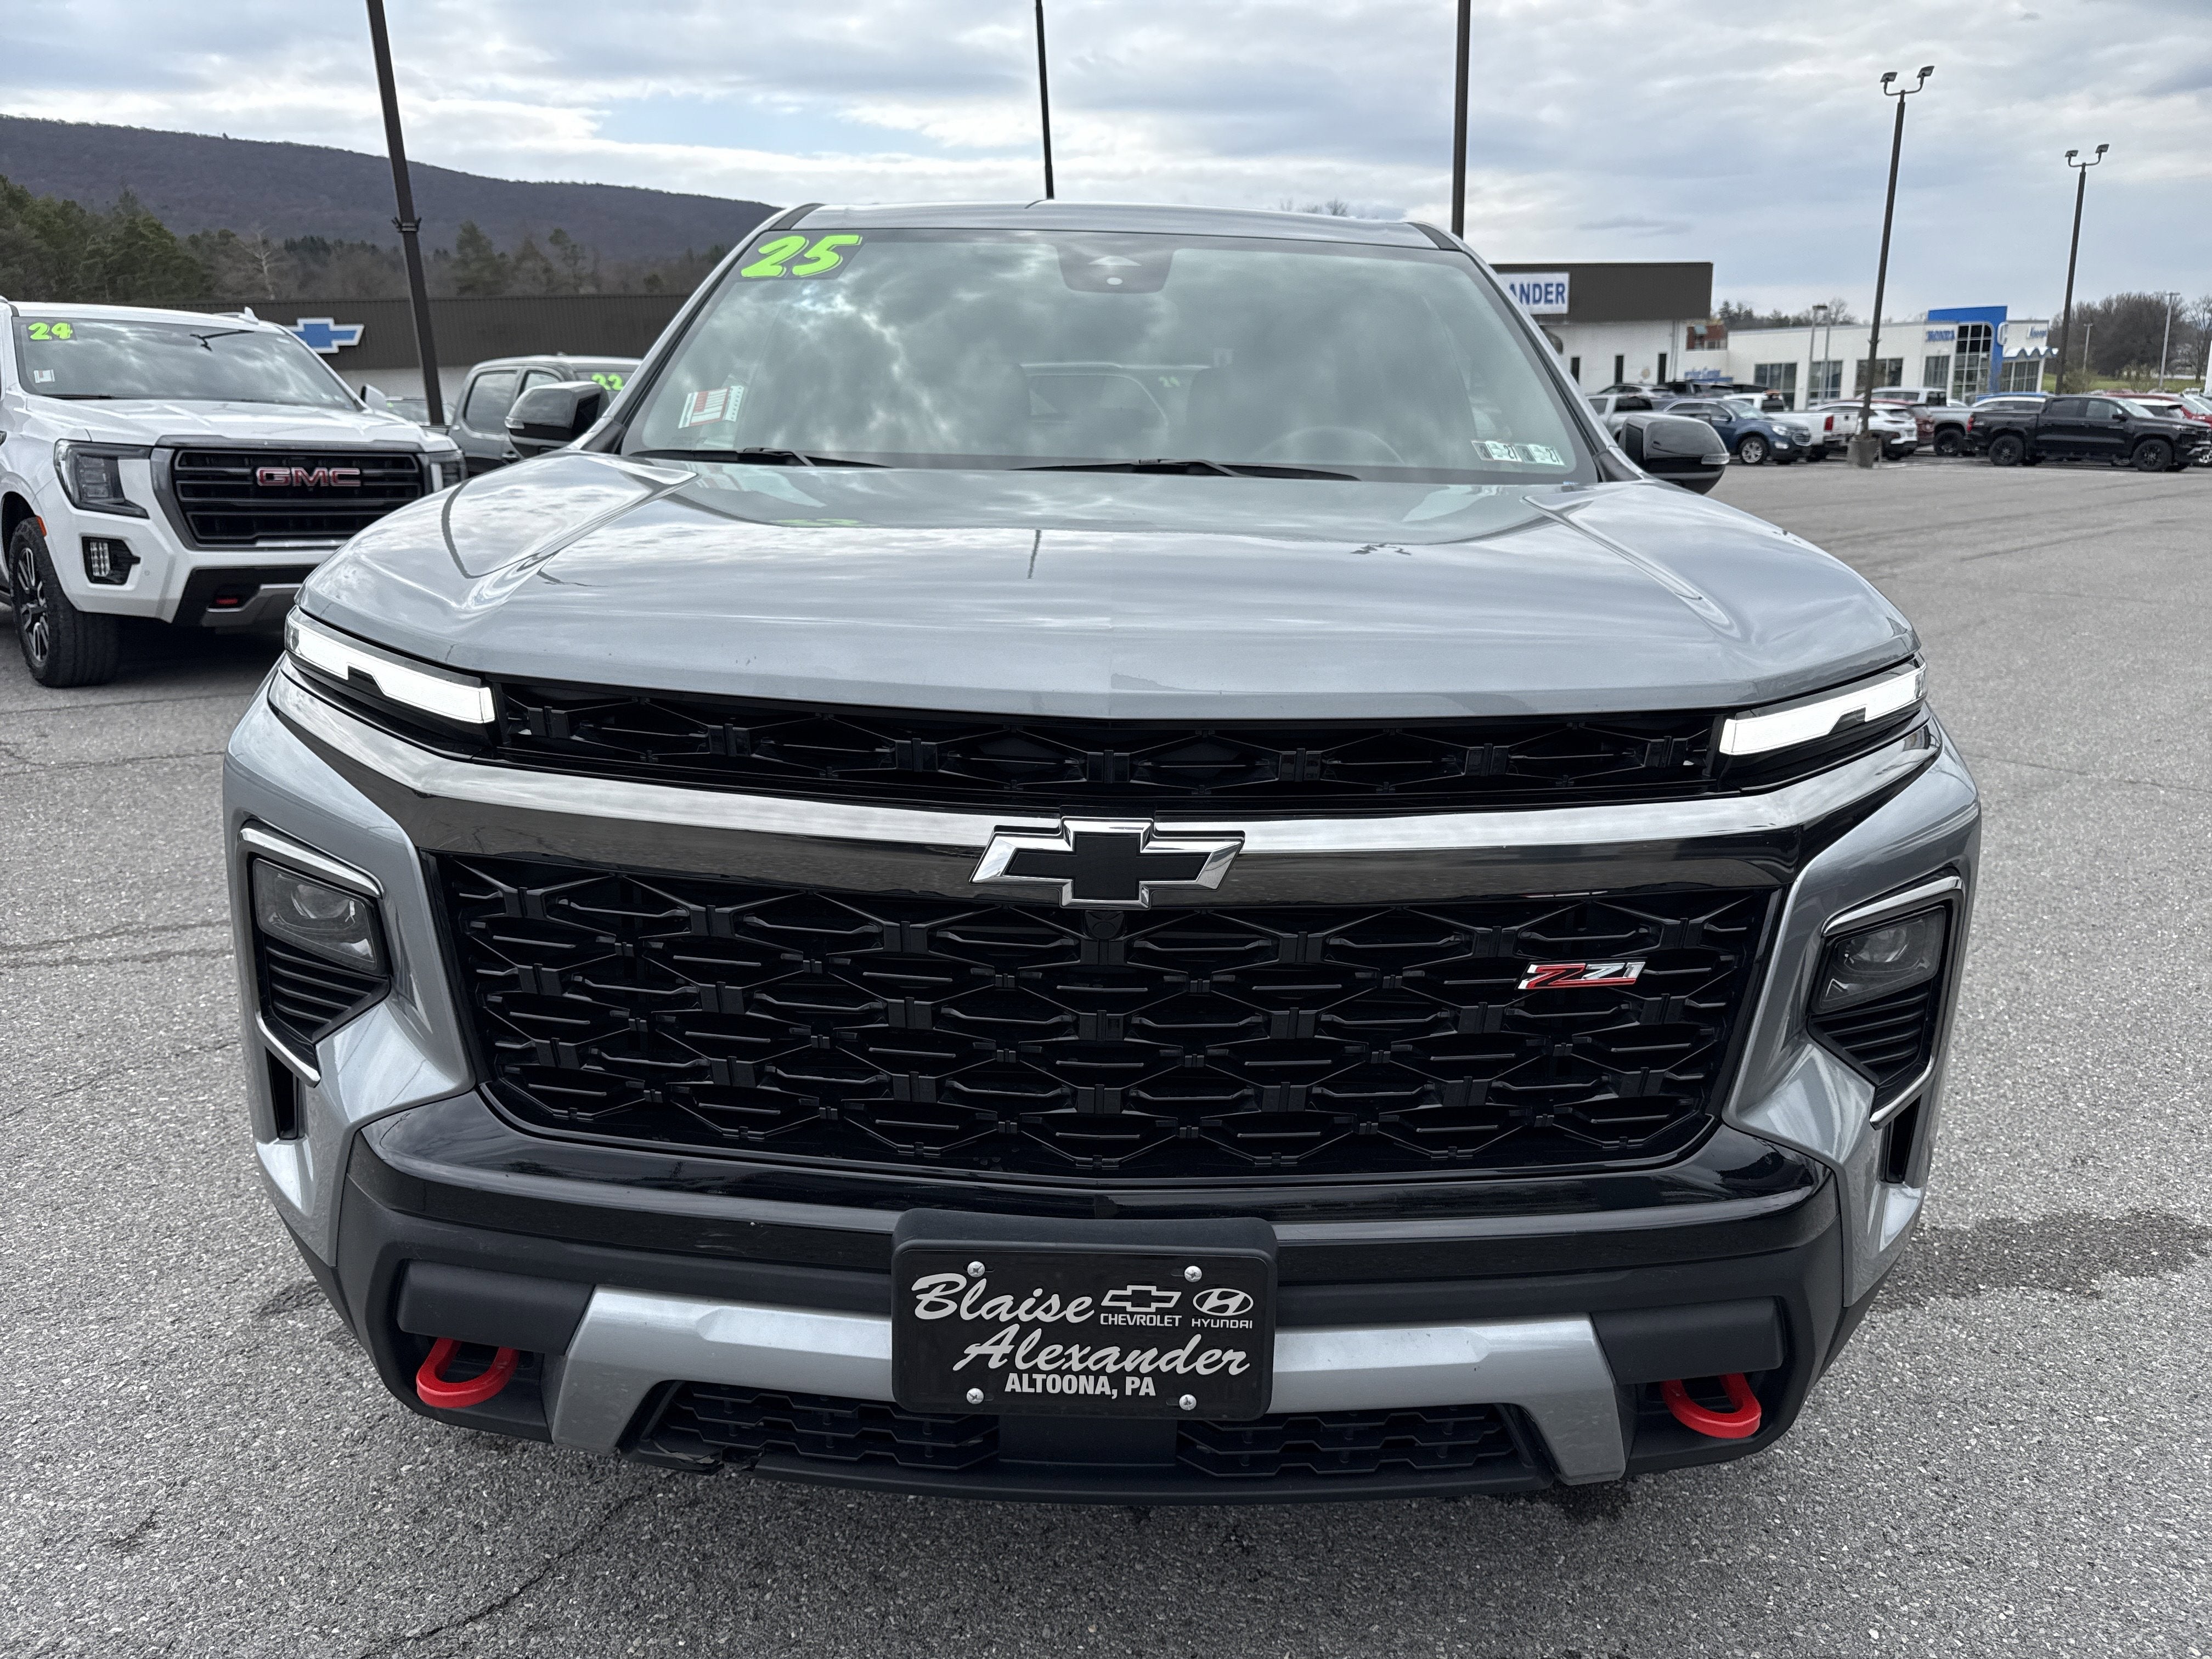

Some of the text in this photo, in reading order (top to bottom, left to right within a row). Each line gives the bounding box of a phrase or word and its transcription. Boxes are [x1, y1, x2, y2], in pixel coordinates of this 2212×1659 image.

[741, 234, 862, 278] 25
[28, 322, 72, 340] 24
[591, 373, 624, 391] 22
[256, 466, 362, 487] GMC
[911, 1272, 1095, 1323] Blaise
[1100, 1313, 1182, 1327] CHEVROLET
[1192, 1318, 1253, 1329] HYUNDAI
[952, 1323, 1250, 1375] Alexander
[1005, 1373, 1156, 1400] ALTOONA, PA
